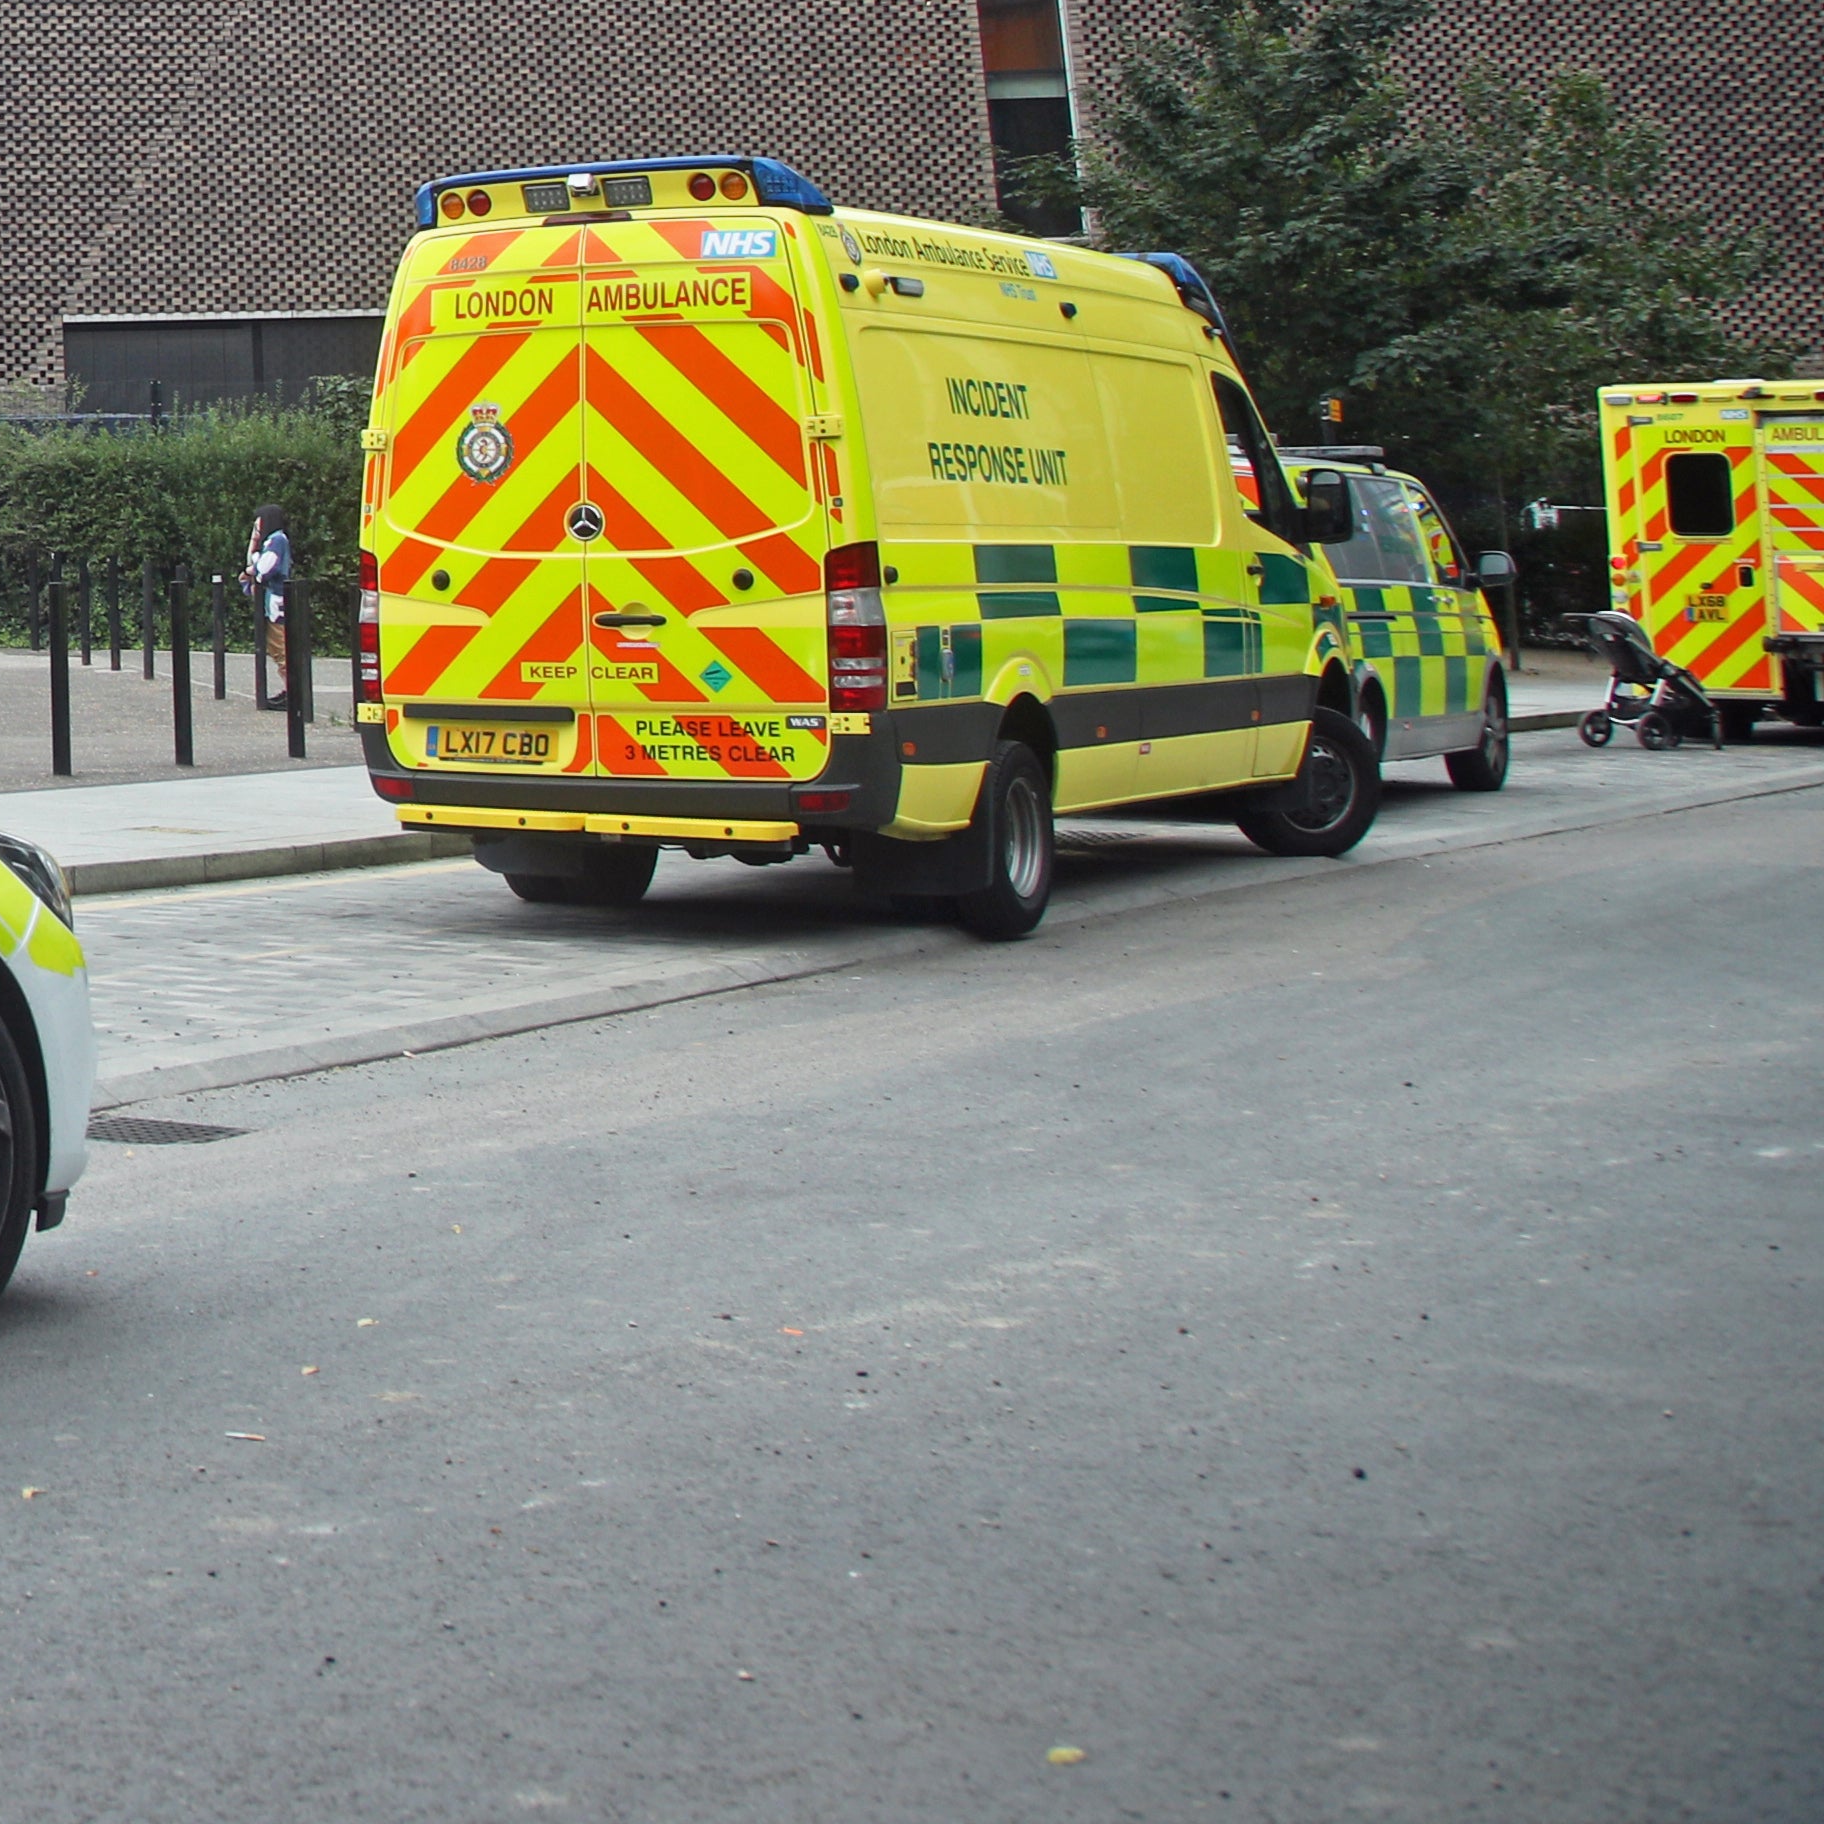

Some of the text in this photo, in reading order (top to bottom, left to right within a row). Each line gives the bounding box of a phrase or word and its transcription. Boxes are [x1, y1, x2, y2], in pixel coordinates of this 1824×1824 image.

[702, 231, 773, 257] NHS
[854, 228, 1032, 277] London Ambulance Service
[450, 256, 487, 272] 8428
[455, 277, 747, 320] LONDON AMBULANCE
[945, 377, 1030, 420] INCIDENT
[1664, 429, 1726, 444] LONDON
[927, 442, 1068, 486] RESPONSE UNIT
[1687, 595, 1725, 608] LX68
[530, 666, 654, 680] KEEP CLEAR
[636, 720, 781, 738] PLEASE LEAVE
[789, 717, 820, 727] WAS
[444, 730, 497, 755] LX17
[625, 744, 796, 763] 3 METRES CLEAR
